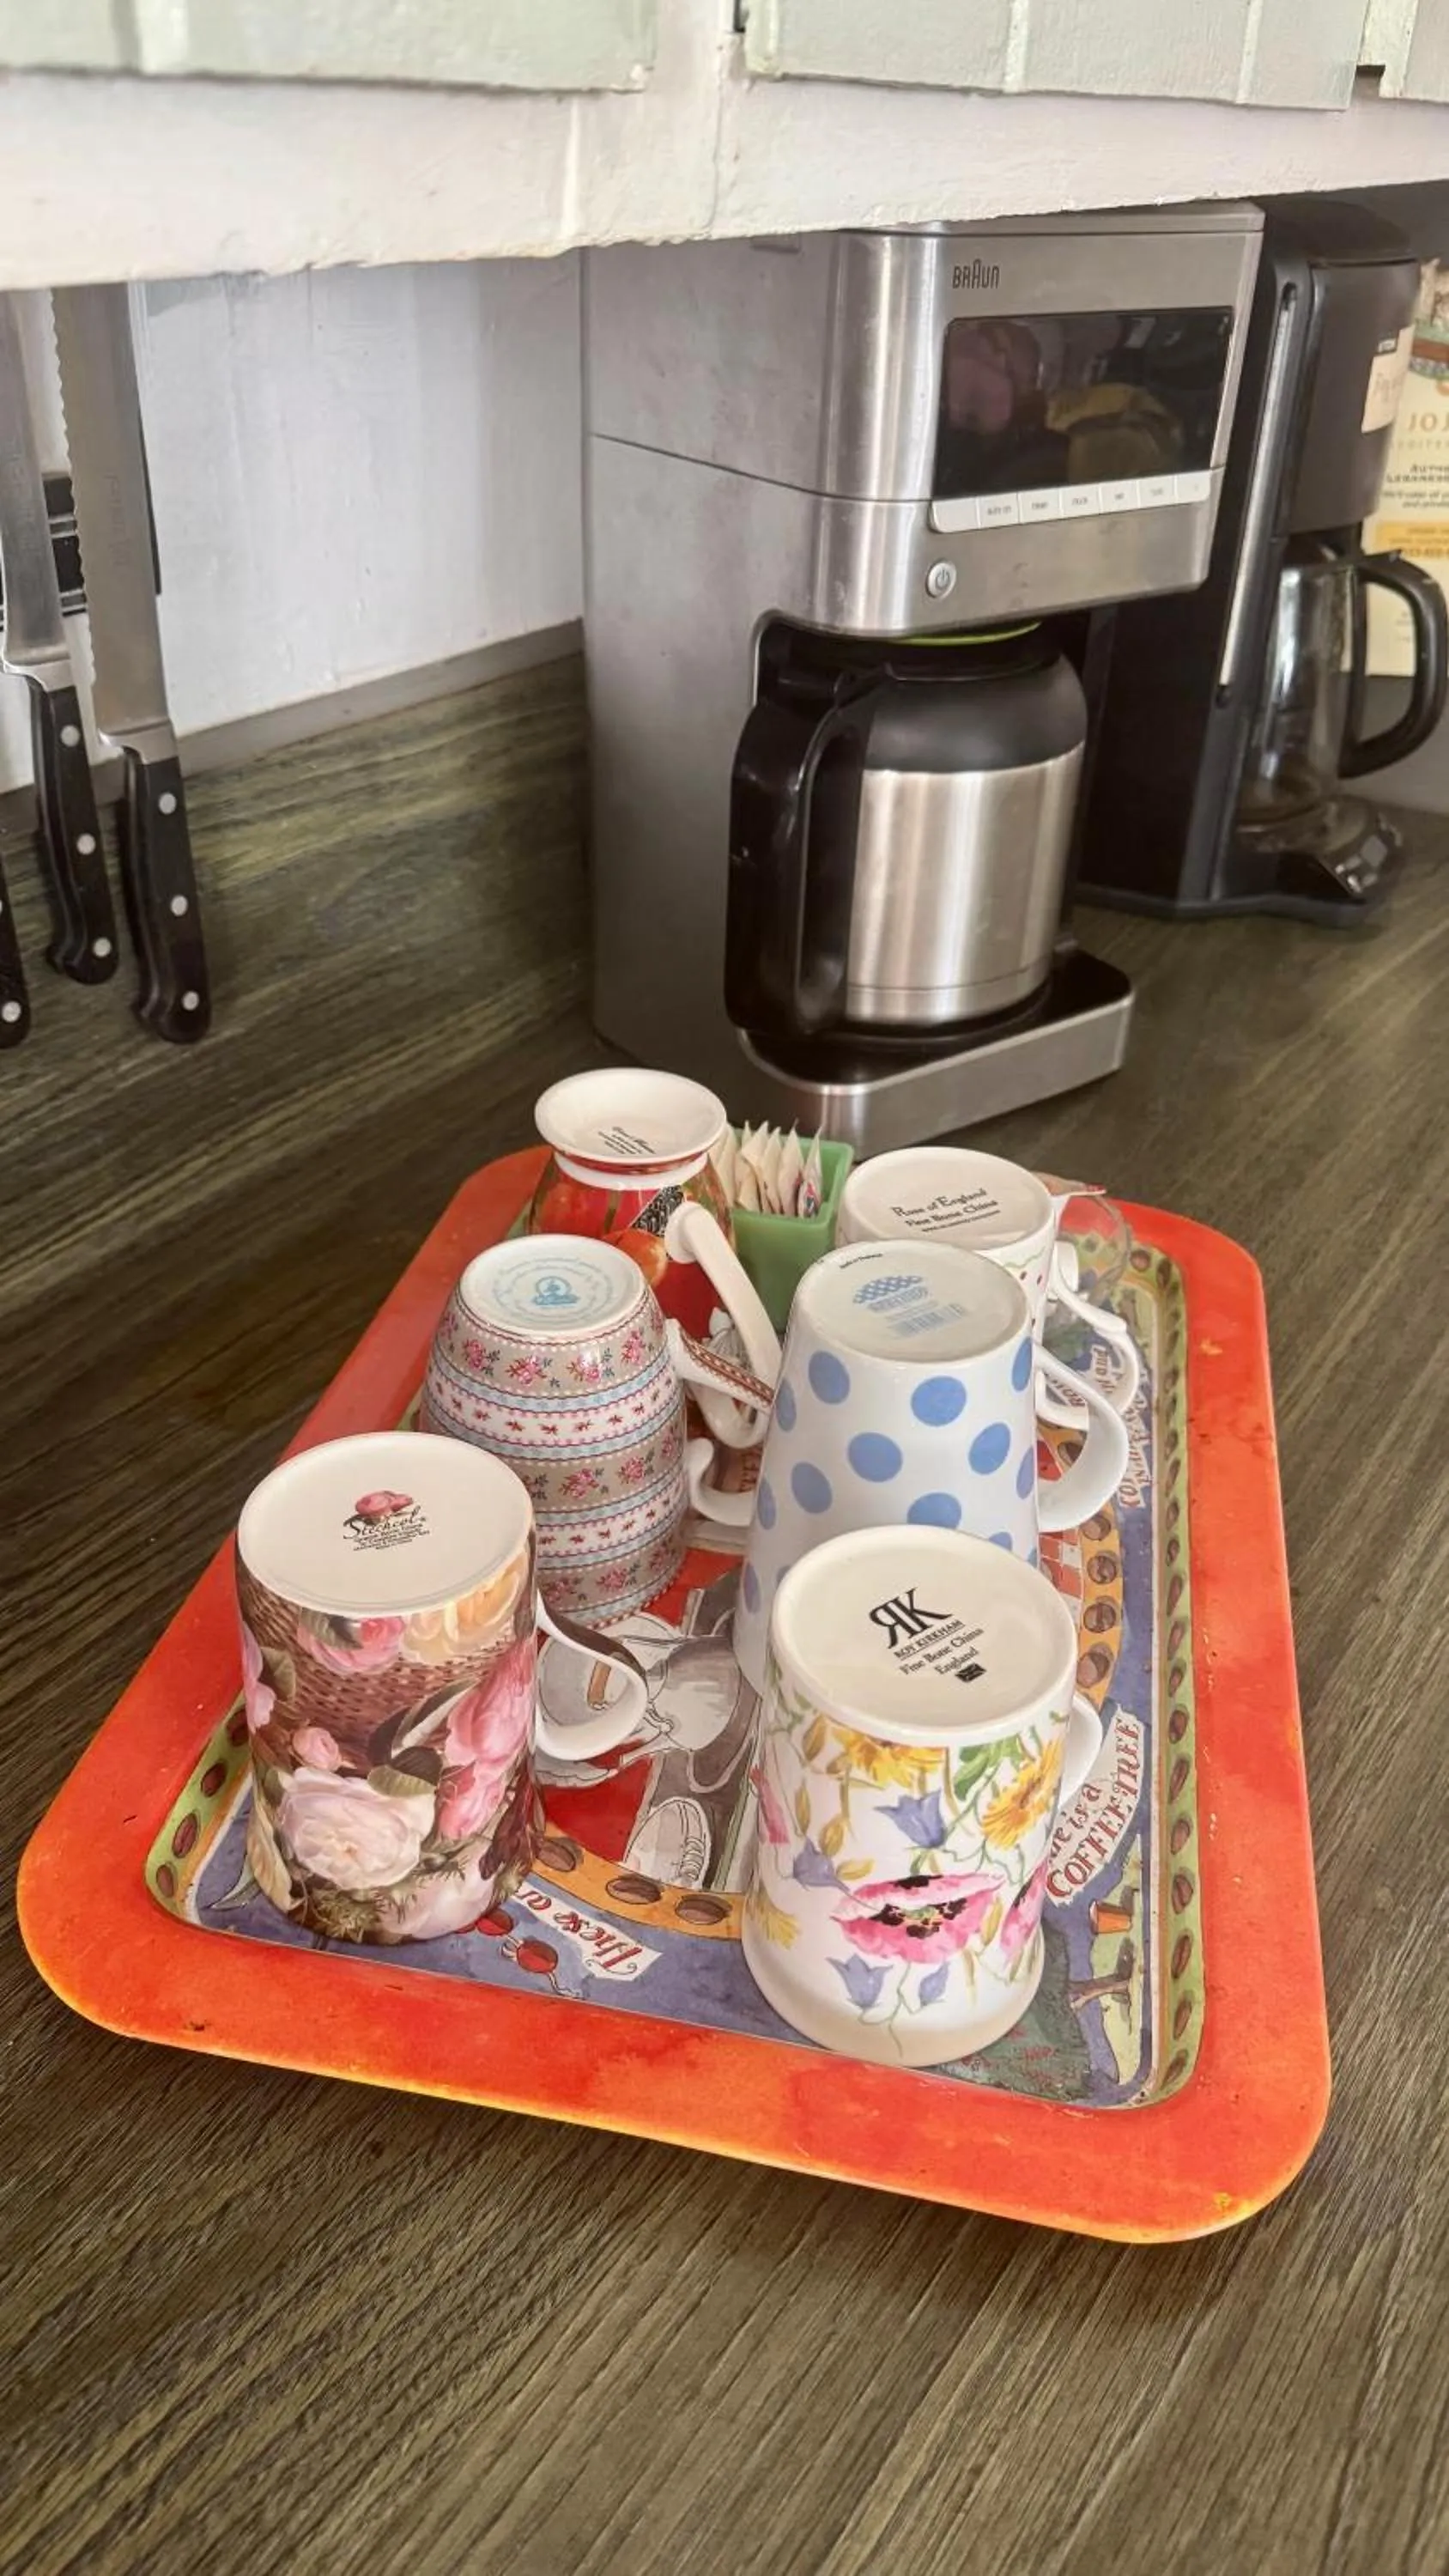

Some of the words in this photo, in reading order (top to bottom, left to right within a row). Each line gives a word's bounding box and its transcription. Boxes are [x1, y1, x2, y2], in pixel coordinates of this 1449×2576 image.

[952, 259, 1000, 289] BRAUN
[935, 1188, 987, 1207] England
[915, 1619, 964, 1648] KIRKHAM
[900, 1660, 926, 1675] Fine
[923, 1646, 953, 1663] Bone
[950, 1628, 985, 1648] China
[934, 1646, 979, 1674] England
[1046, 1793, 1134, 1898] COFFEE
[1114, 1719, 1141, 1798] TREE
